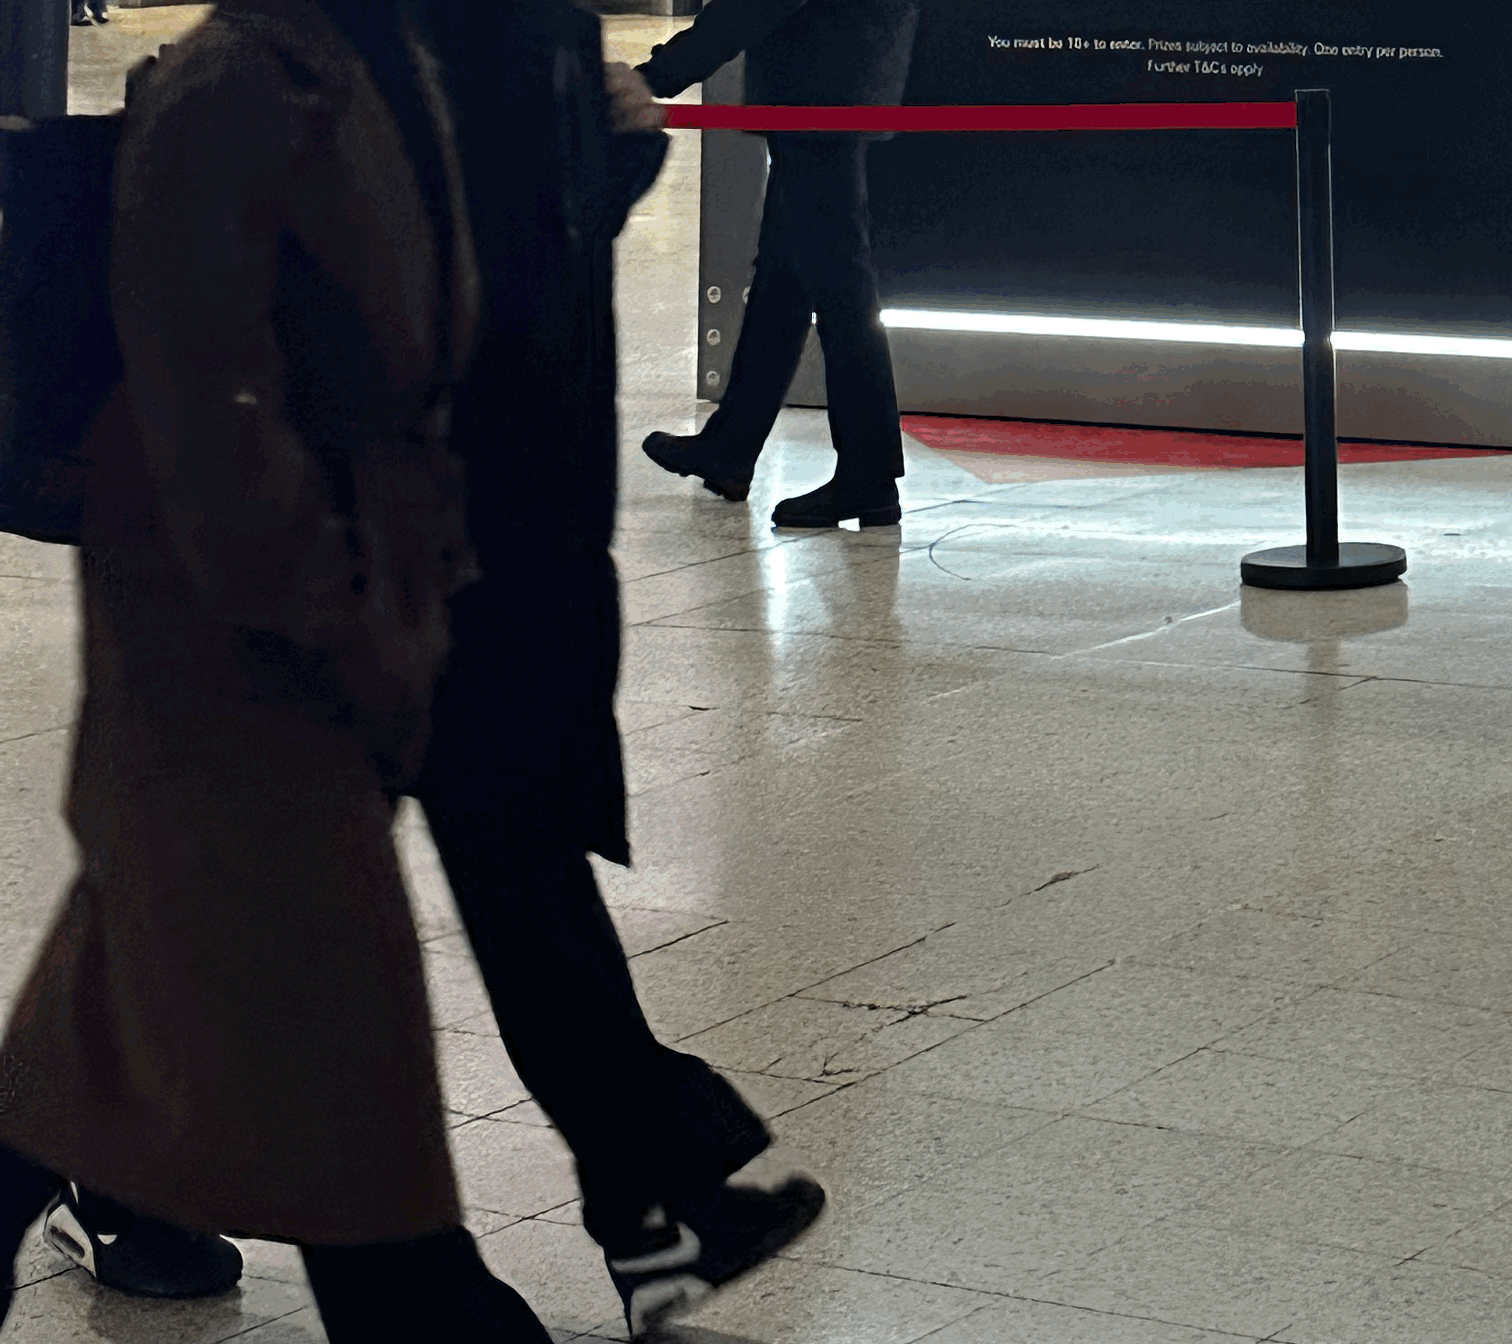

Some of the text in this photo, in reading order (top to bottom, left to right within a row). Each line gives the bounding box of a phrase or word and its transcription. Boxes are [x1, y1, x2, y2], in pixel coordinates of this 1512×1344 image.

[988, 35, 1011, 49] You
[1014, 38, 1046, 49] must
[1048, 37, 1063, 49] be
[1094, 38, 1106, 50] to
[1148, 38, 1182, 51] Prizes
[1186, 39, 1228, 55] subject
[1231, 41, 1243, 54] to
[1314, 42, 1338, 56] One
[1342, 44, 1373, 59] entry
[1376, 46, 1396, 59] per
